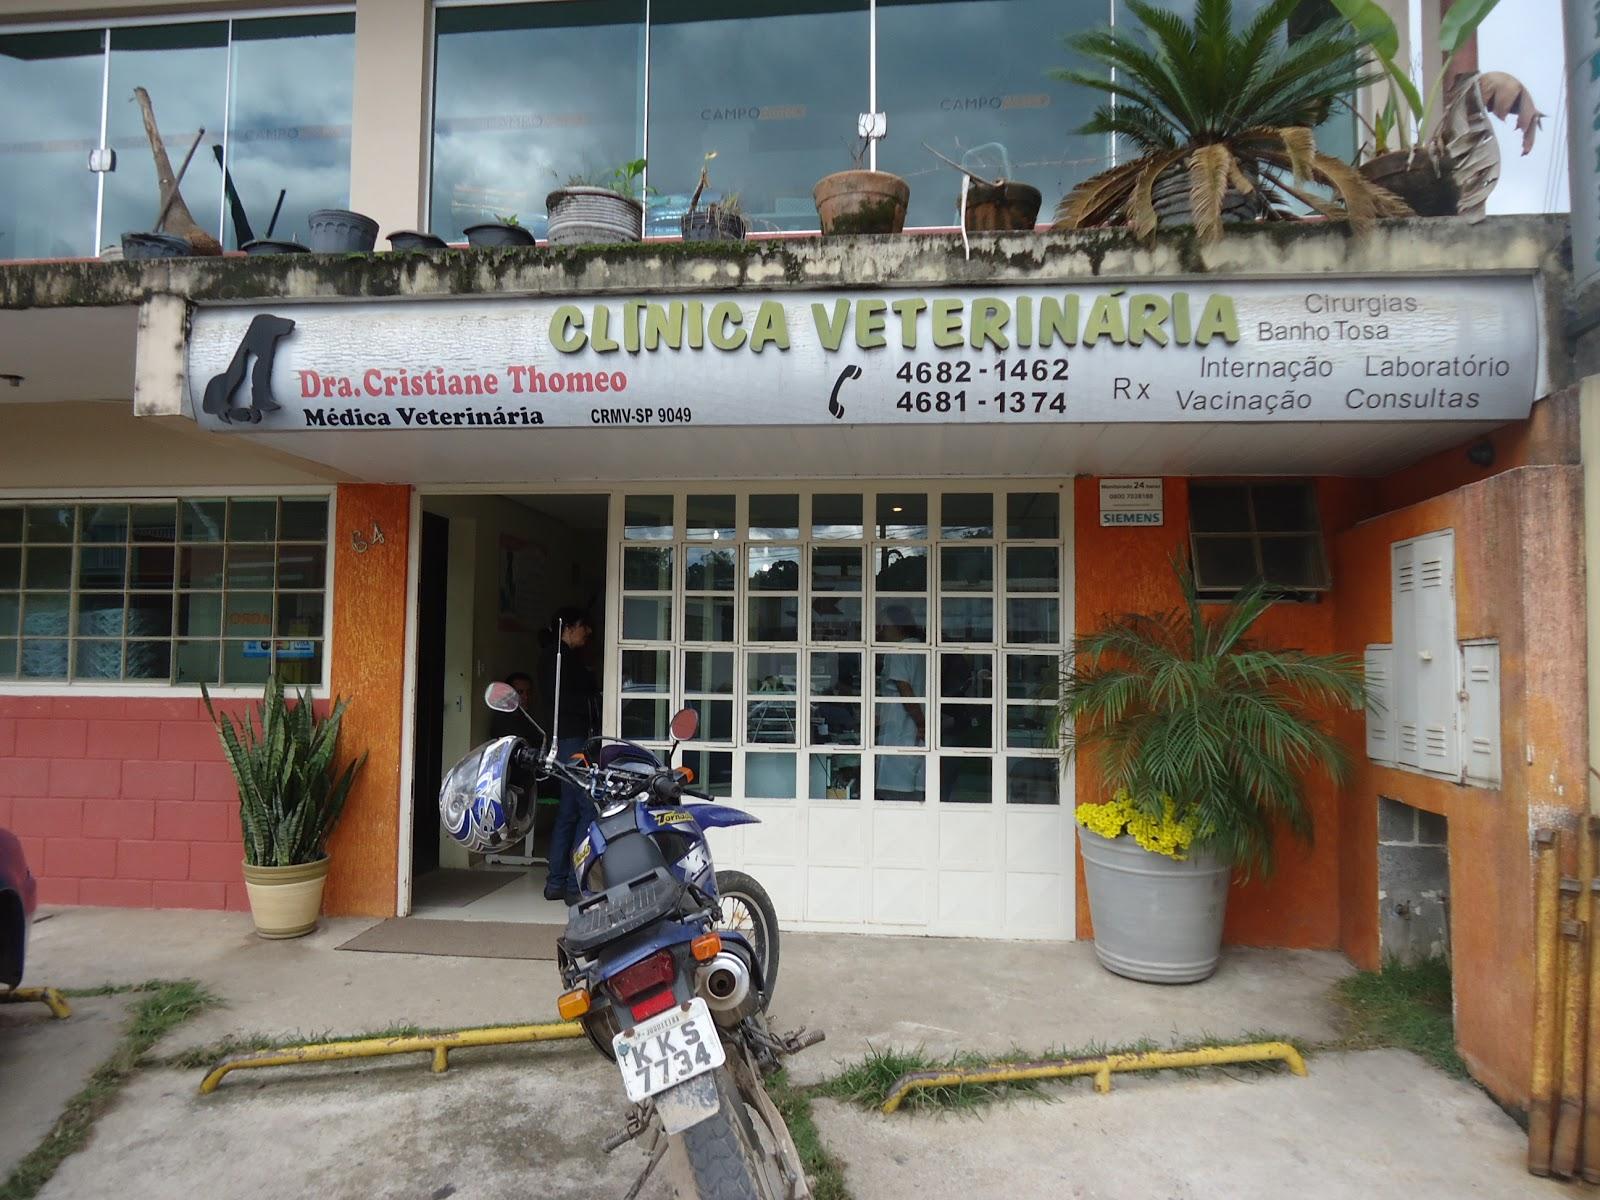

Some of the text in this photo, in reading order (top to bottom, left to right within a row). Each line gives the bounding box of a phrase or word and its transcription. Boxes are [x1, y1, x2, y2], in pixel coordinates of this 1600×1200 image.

[1305, 293, 1418, 318] Cirurgias
[548, 286, 1241, 354] CLÍNICA VETERINÁRIA
[1258, 320, 1390, 342] Banho Tosa
[1200, 356, 1333, 382] Internação
[1365, 354, 1510, 377] Laboratório
[507, 365, 627, 394] Thomeo
[1113, 377, 1151, 400] Rx
[1176, 390, 1312, 415] Vacinação
[1345, 388, 1480, 409] Consultas
[303, 406, 544, 427] Médica Veterinária
[591, 407, 692, 424] CRMV-SP 9049
[1103, 513, 1161, 523] SIEMENS
[631, 1020, 701, 1069] KKS
[635, 1041, 712, 1093] 7734
